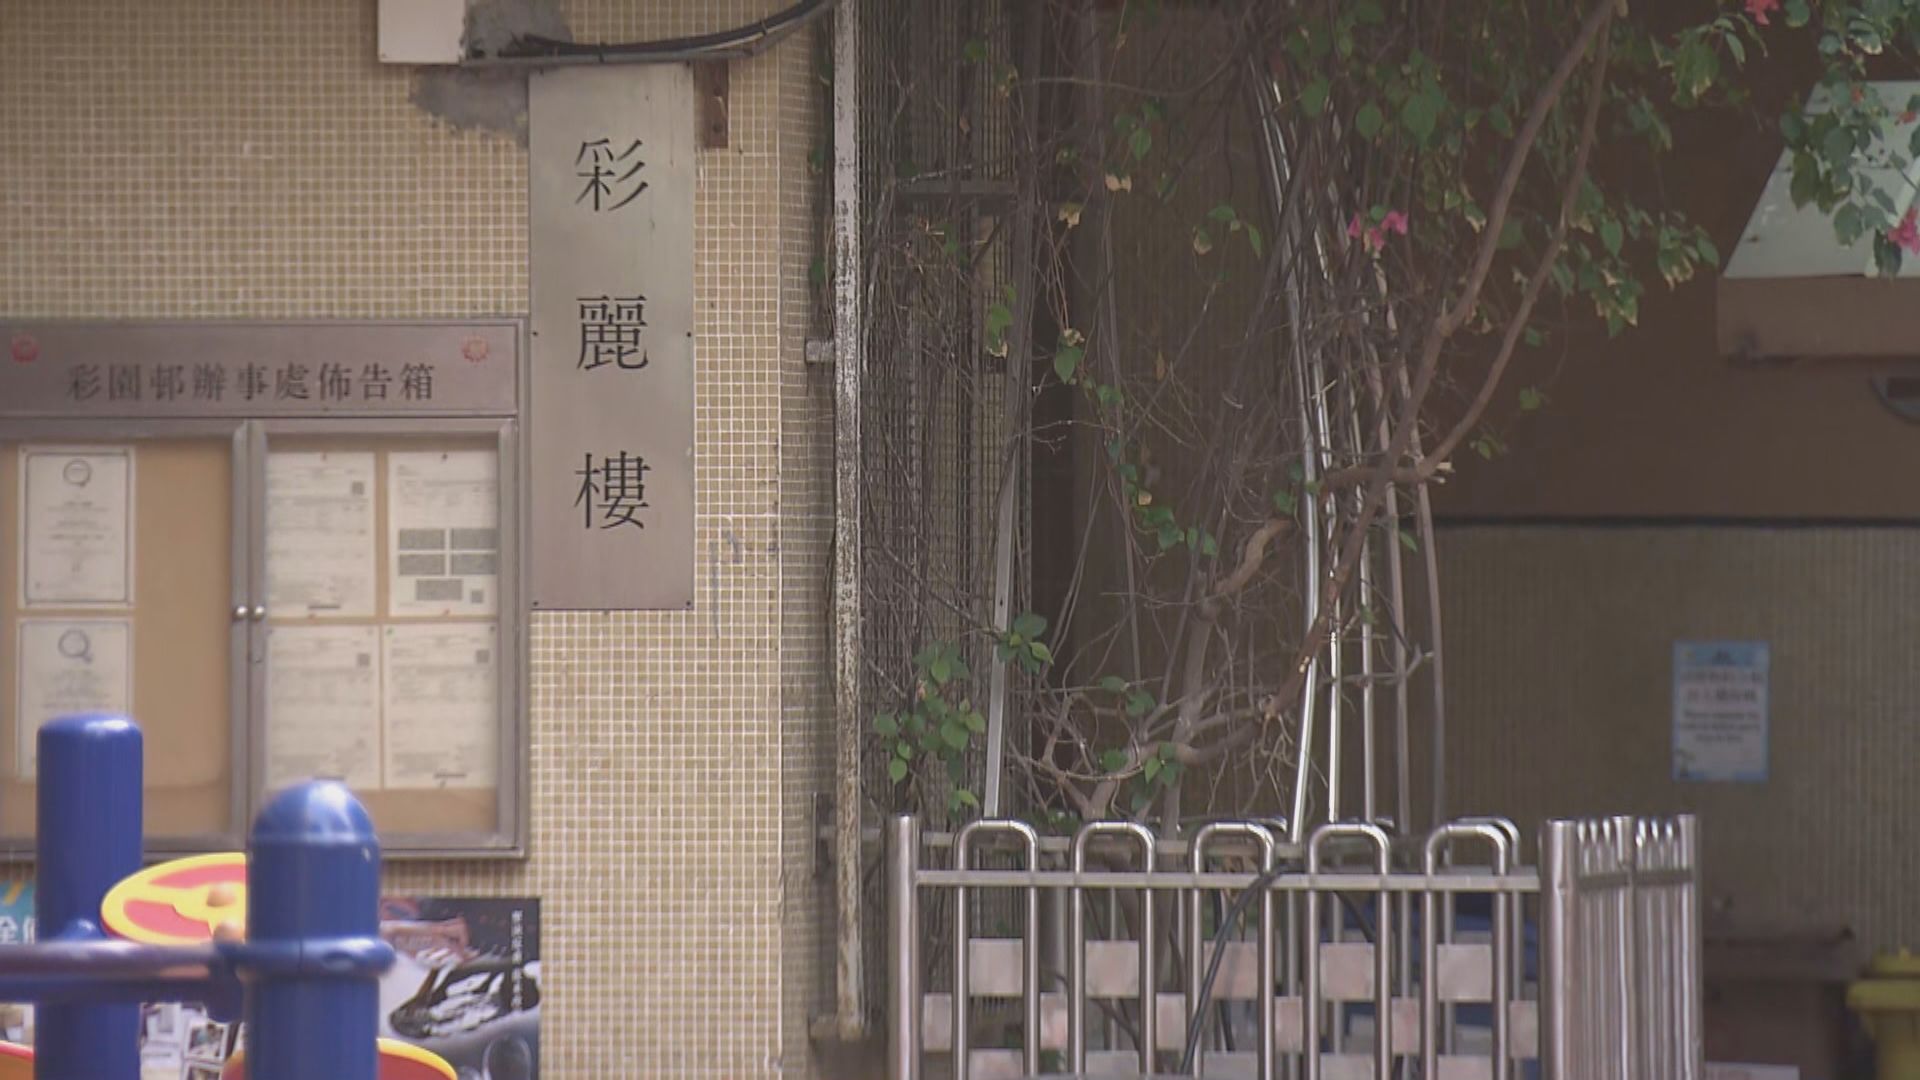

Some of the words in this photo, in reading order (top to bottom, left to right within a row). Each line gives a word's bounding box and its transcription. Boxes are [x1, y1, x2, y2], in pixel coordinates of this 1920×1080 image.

[67, 362, 436, 401] 彩園邨辦事處佈告箱
[574, 137, 650, 530] 彩麗樓
